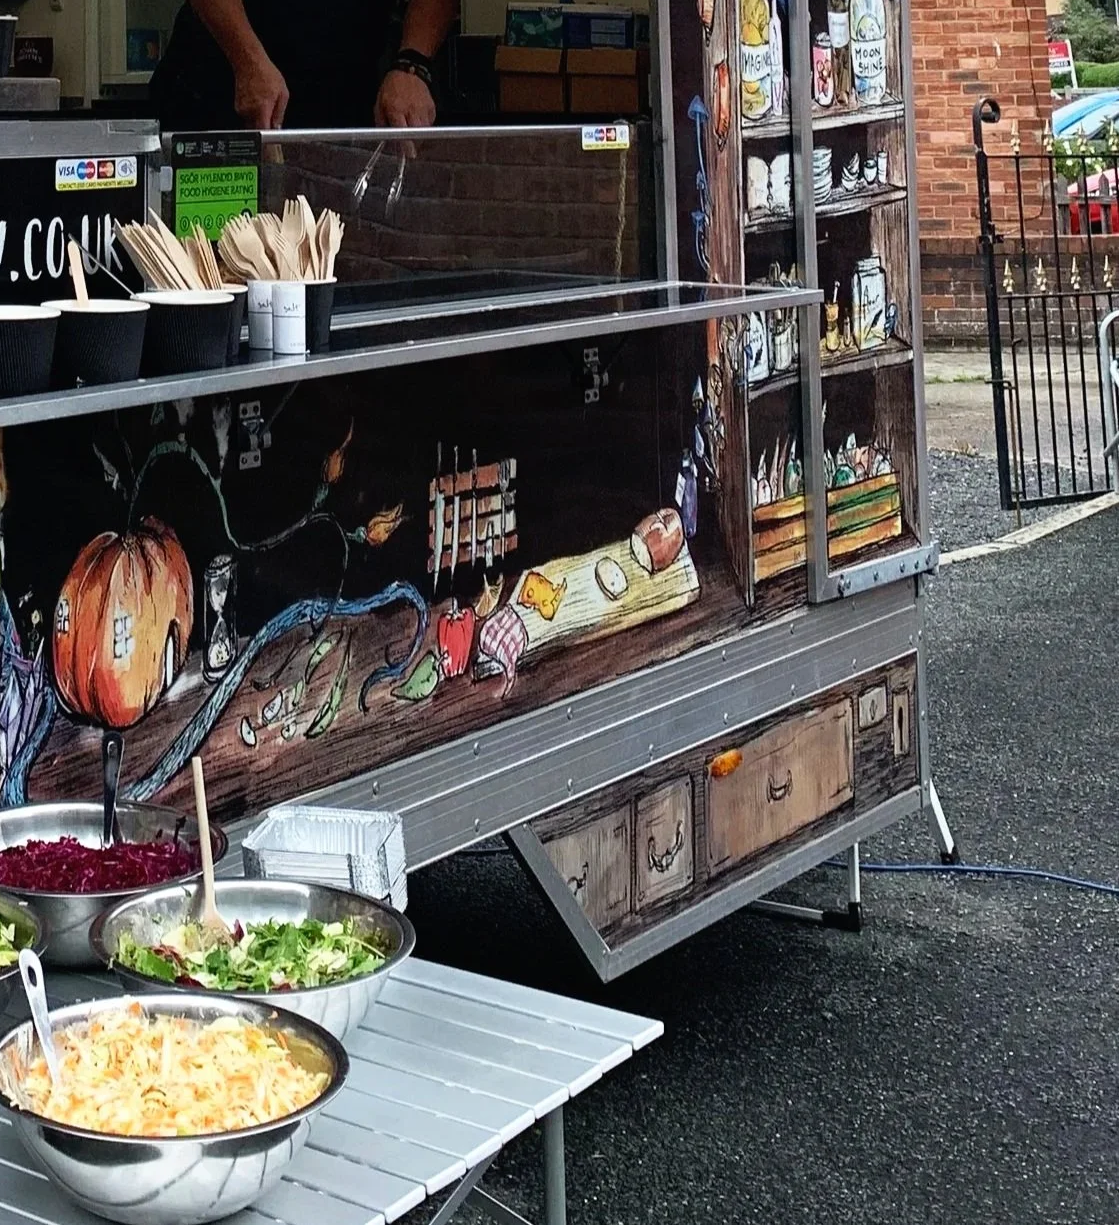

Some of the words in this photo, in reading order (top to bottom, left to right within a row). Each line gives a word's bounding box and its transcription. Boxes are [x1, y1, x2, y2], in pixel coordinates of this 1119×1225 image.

[854, 46, 882, 61] MOON
[858, 56, 884, 77] SHINE
[58, 166, 75, 177] VISA
[179, 187, 201, 198] FOOD
[202, 186, 229, 196] HYGIENE
[230, 184, 254, 195] RATING
